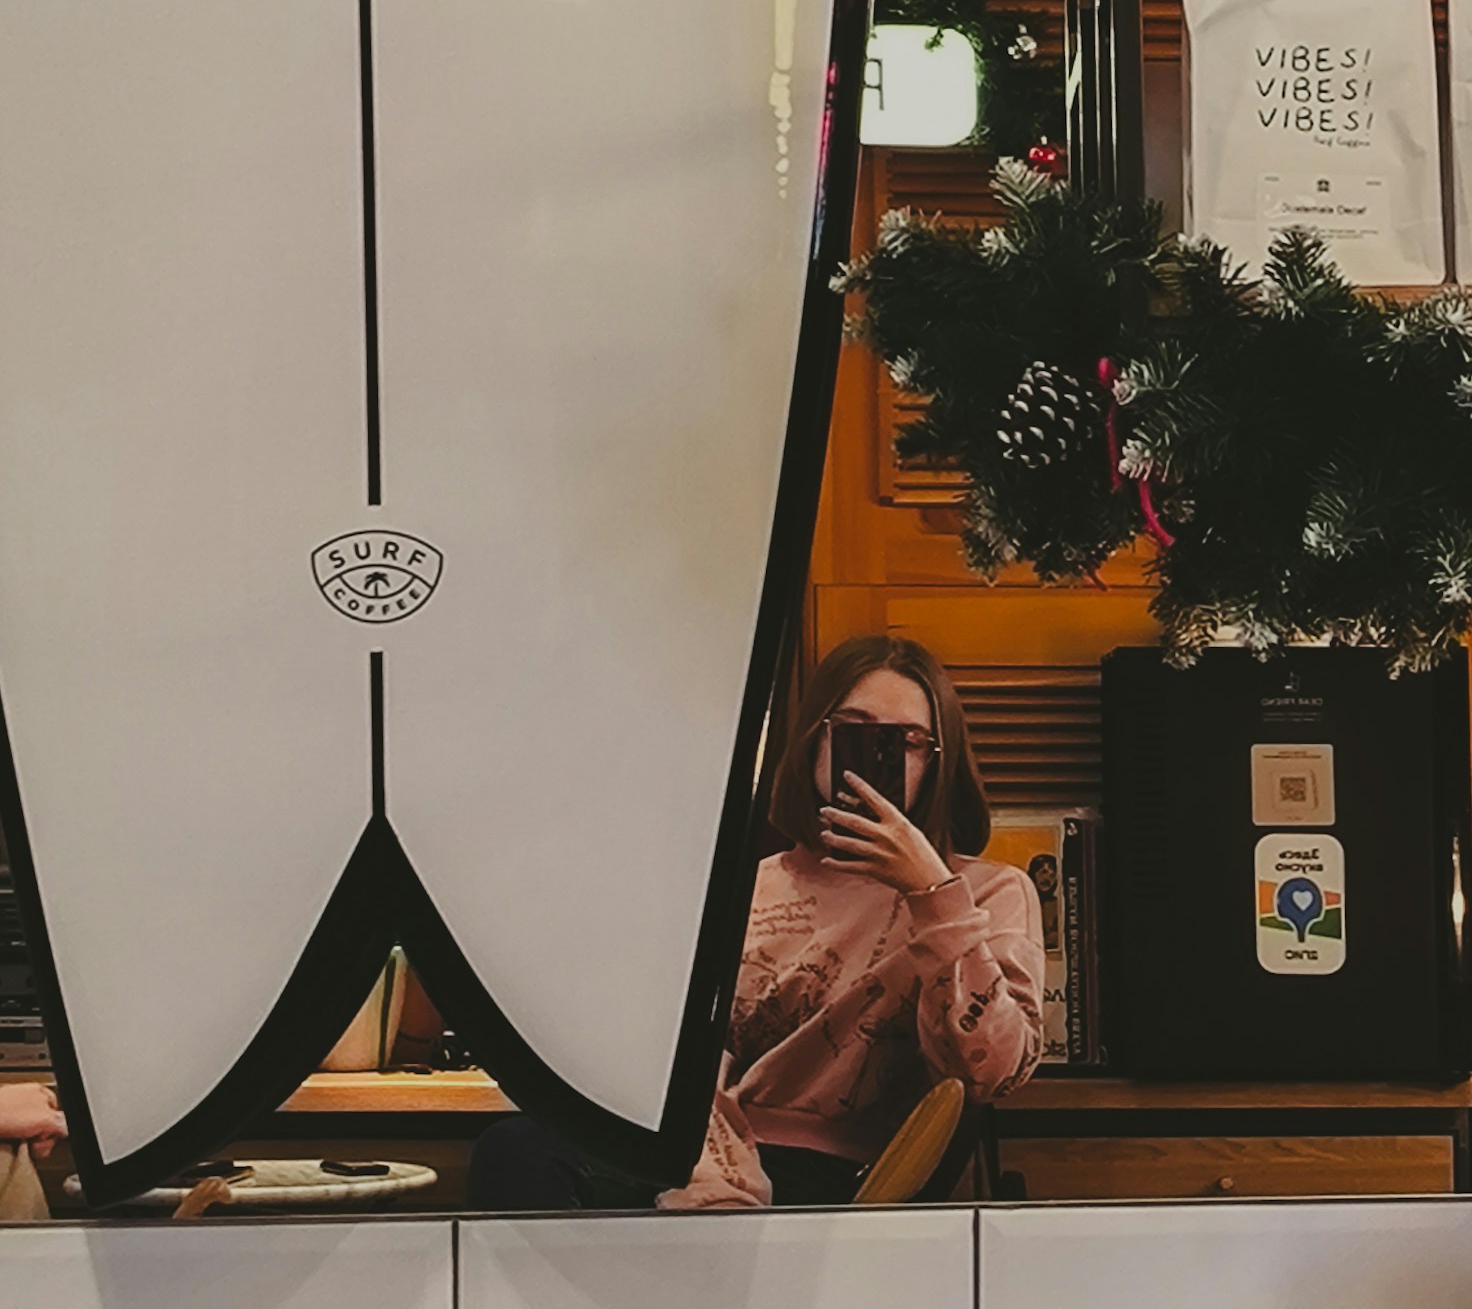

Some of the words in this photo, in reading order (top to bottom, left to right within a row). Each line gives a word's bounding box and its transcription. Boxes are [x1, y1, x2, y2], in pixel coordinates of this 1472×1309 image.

[1255, 45, 1371, 73] VIBES!
[1255, 76, 1373, 106] VIBES!
[1258, 106, 1374, 136] VIBES!
[329, 541, 427, 569] SURF
[334, 588, 421, 615] COFFEE
